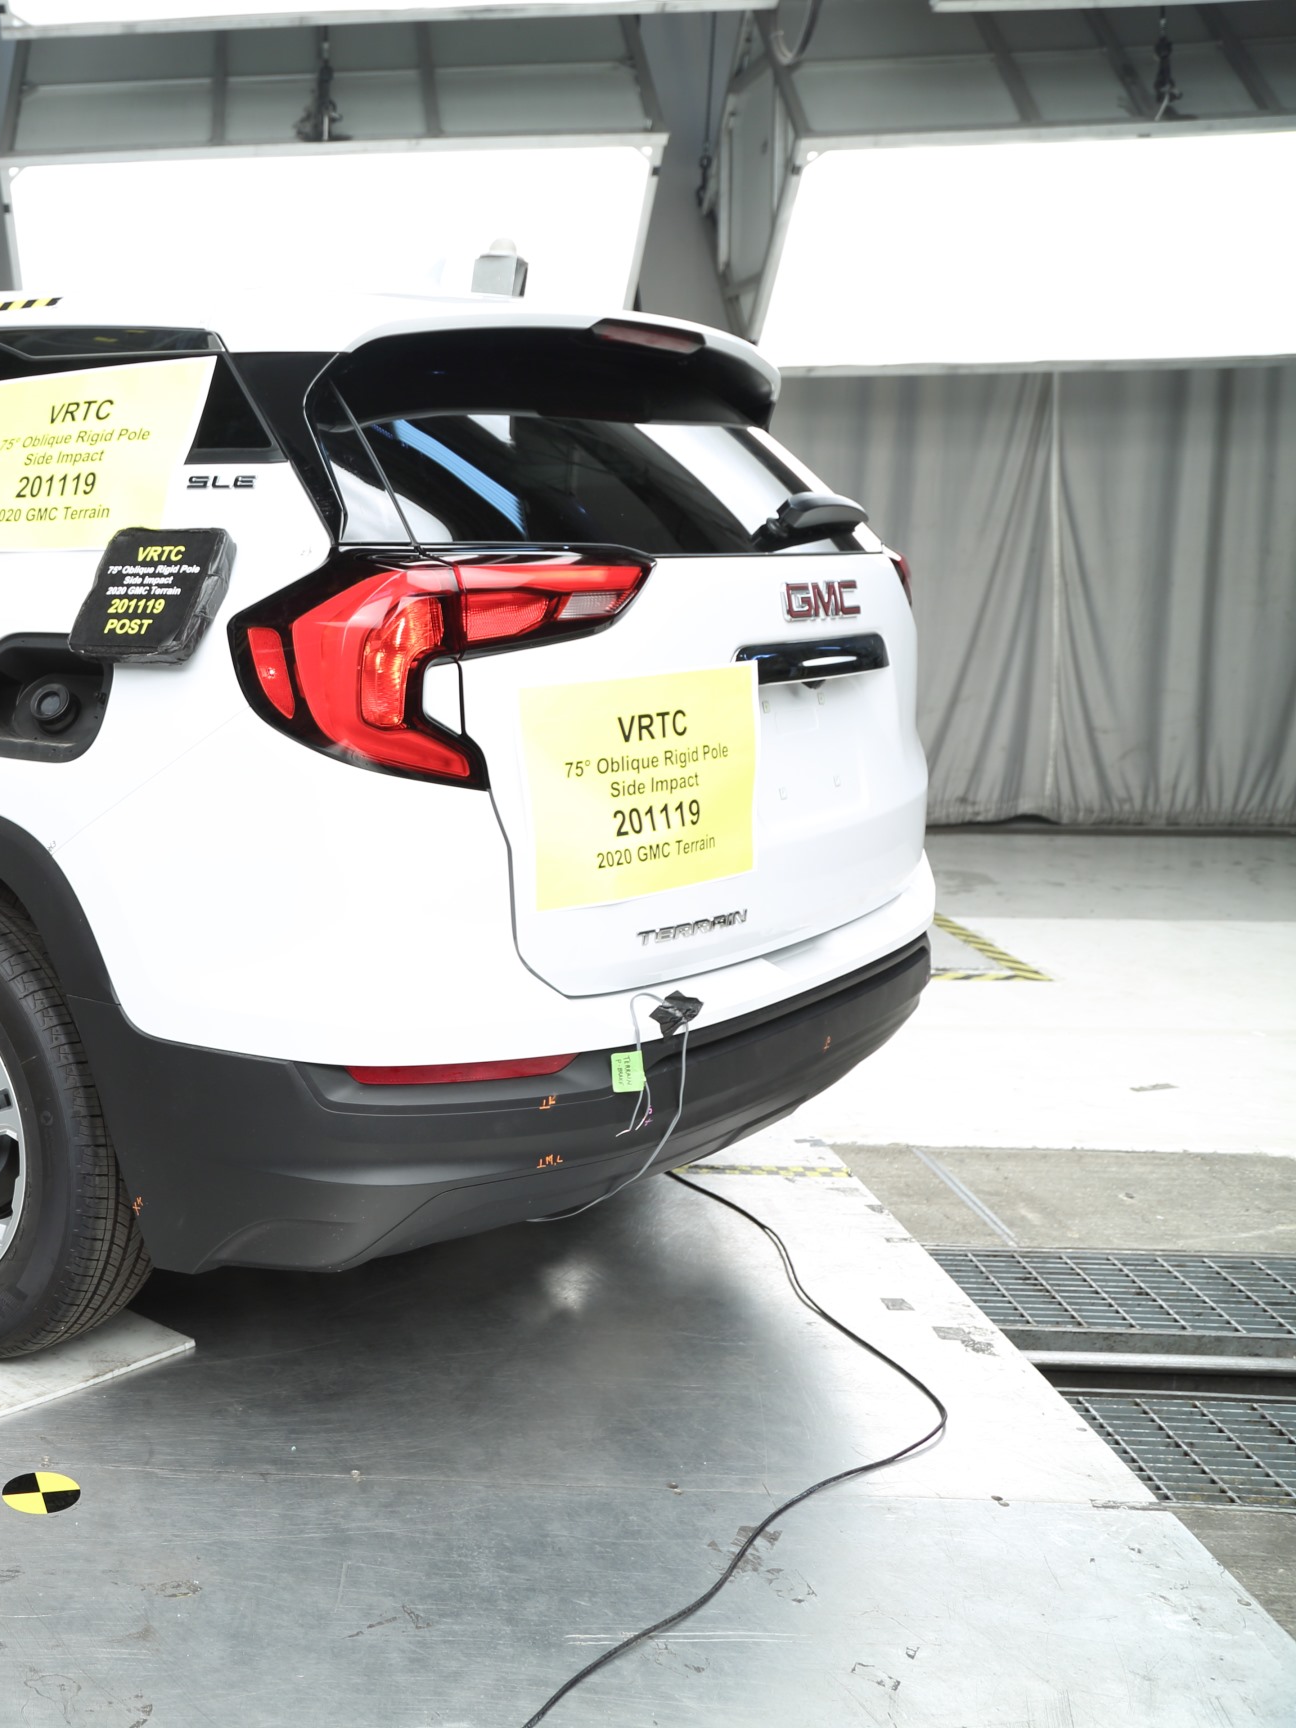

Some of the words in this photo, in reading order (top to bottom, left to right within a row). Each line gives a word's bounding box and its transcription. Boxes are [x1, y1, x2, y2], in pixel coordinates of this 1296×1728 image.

[49, 399, 114, 424] VRTC
[0, 437, 22, 451] 75°
[22, 433, 72, 449] Oblique
[76, 429, 114, 446] Rigid
[117, 428, 151, 441] Pole
[24, 453, 53, 466] Side
[57, 450, 104, 466] Impact
[15, 472, 96, 498] 201119
[186, 475, 257, 489] SLE
[26, 507, 59, 521] GMC
[63, 504, 110, 520] Terrain
[137, 546, 185, 561] VRTC
[122, 566, 154, 575] Oblique
[155, 565, 179, 575] Rigid
[180, 565, 200, 574] Pole
[123, 576, 142, 584] Side
[143, 576, 174, 585] Impact
[106, 587, 127, 595] 2020
[128, 586, 149, 595] GMC
[151, 586, 181, 595] Terrain
[782, 580, 861, 621] GMC
[107, 599, 165, 613] 201119
[104, 619, 153, 634] POST
[617, 709, 687, 742] VRTC
[565, 760, 591, 778] 75°
[596, 755, 659, 774] Oblique
[664, 747, 699, 768] Rigid
[703, 743, 729, 760] Pole
[610, 780, 646, 798] Side
[651, 772, 699, 794] Impact
[613, 799, 701, 837] 201119
[597, 849, 632, 869] 2020
[637, 842, 671, 862] GMC
[675, 834, 716, 855] Terrain
[637, 909, 747, 945] TERRAIN
